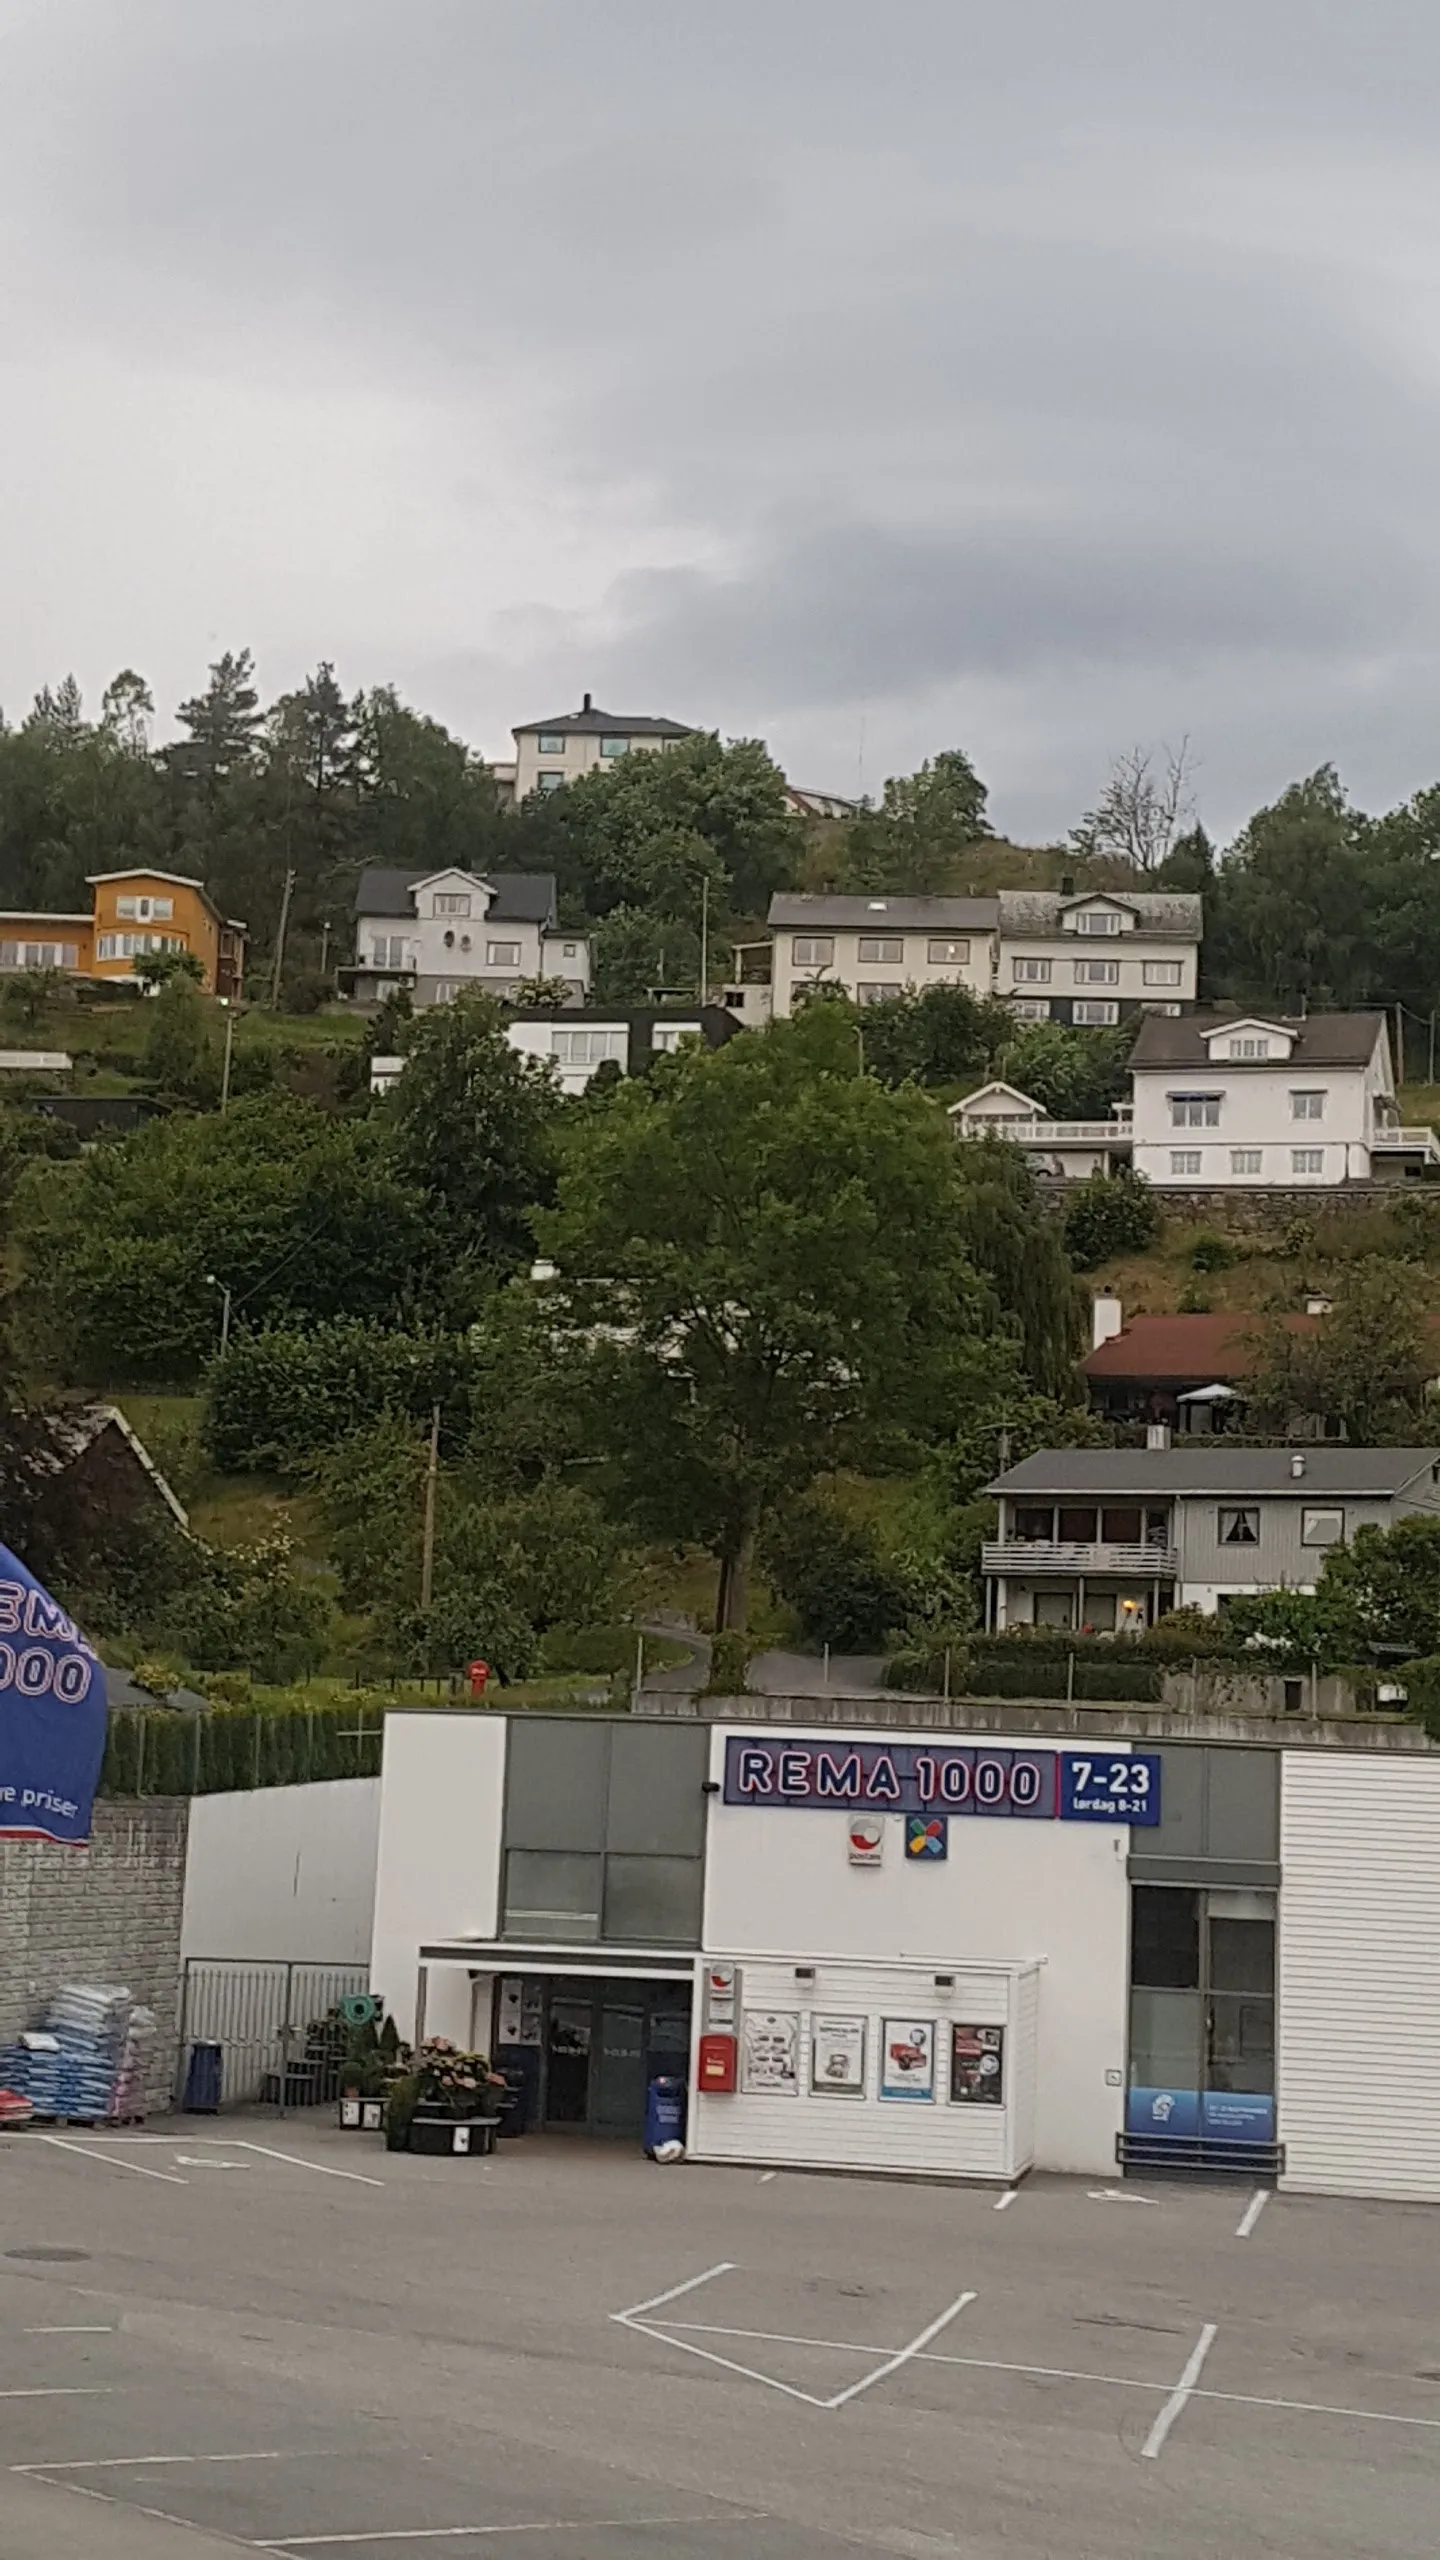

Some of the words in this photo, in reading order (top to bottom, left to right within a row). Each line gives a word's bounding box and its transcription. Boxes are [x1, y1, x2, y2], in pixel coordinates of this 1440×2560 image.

[739, 1750, 900, 1799] REMA
[917, 1757, 1039, 1805] 1000
[1072, 1761, 1149, 1794] 7-23
[20, 1789, 78, 1819] priser
[1118, 1799, 1147, 1812] 8-21
